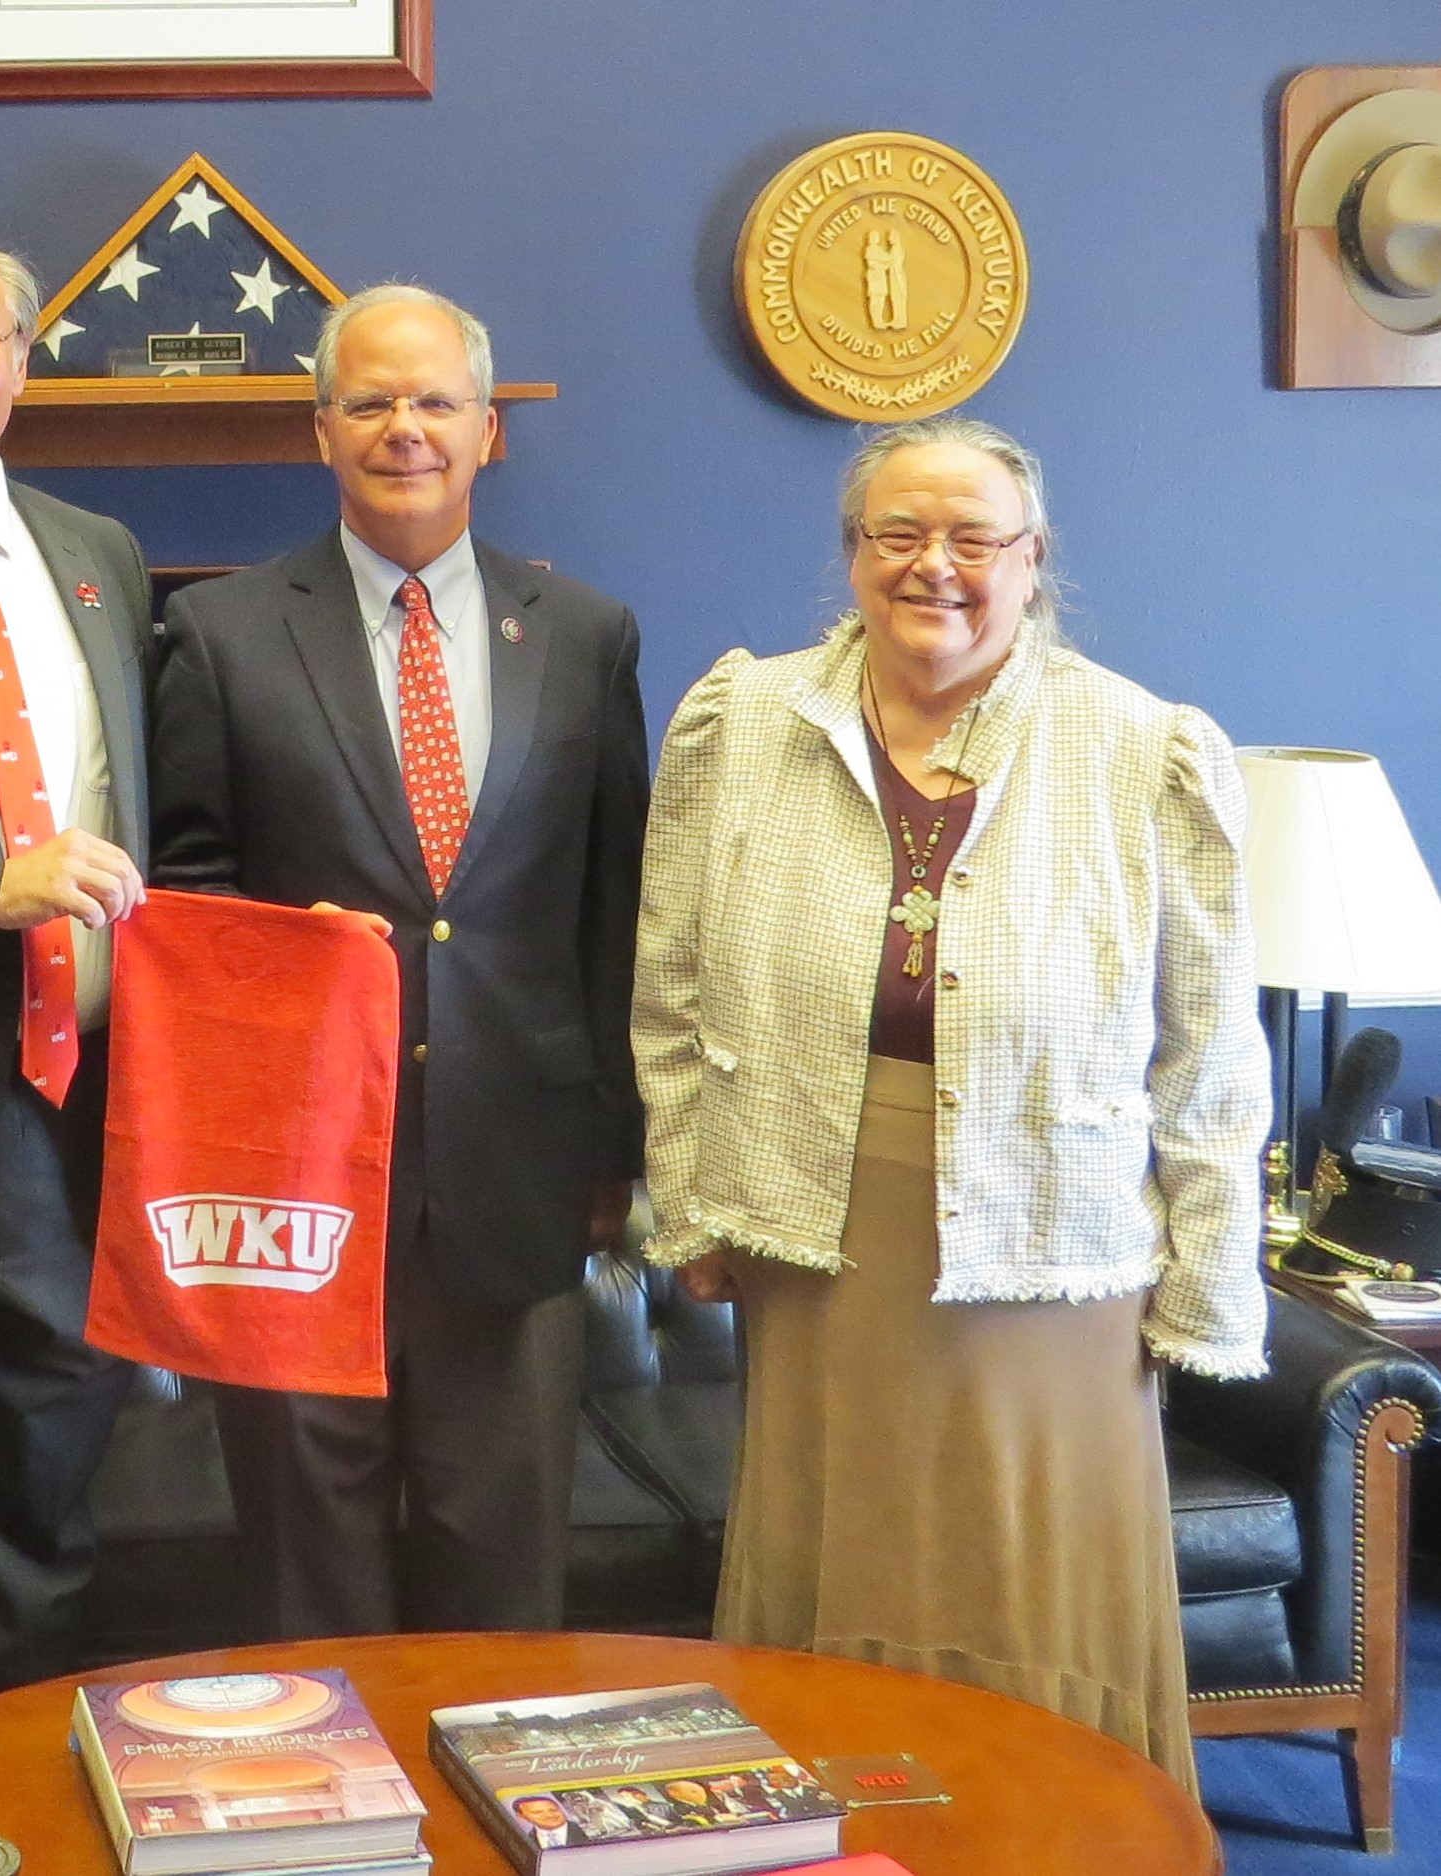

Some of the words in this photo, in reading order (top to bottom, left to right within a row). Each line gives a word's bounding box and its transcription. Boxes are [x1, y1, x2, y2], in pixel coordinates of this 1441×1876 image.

[761, 149, 893, 345] COMMONWEALTH
[911, 155, 948, 187] OF
[952, 180, 1014, 340] KENTUCKY
[816, 204, 864, 250] UNITED
[872, 197, 897, 215] WE
[905, 204, 953, 246] STAND
[820, 313, 885, 360] DIVIDED
[892, 340, 919, 359] WE
[923, 311, 956, 346] FALL
[158, 1203, 344, 1272] WKU
[123, 1739, 224, 1757] EMBASSY
[233, 1726, 370, 1750] RESIDENCES
[526, 1744, 652, 1775] Leadership
